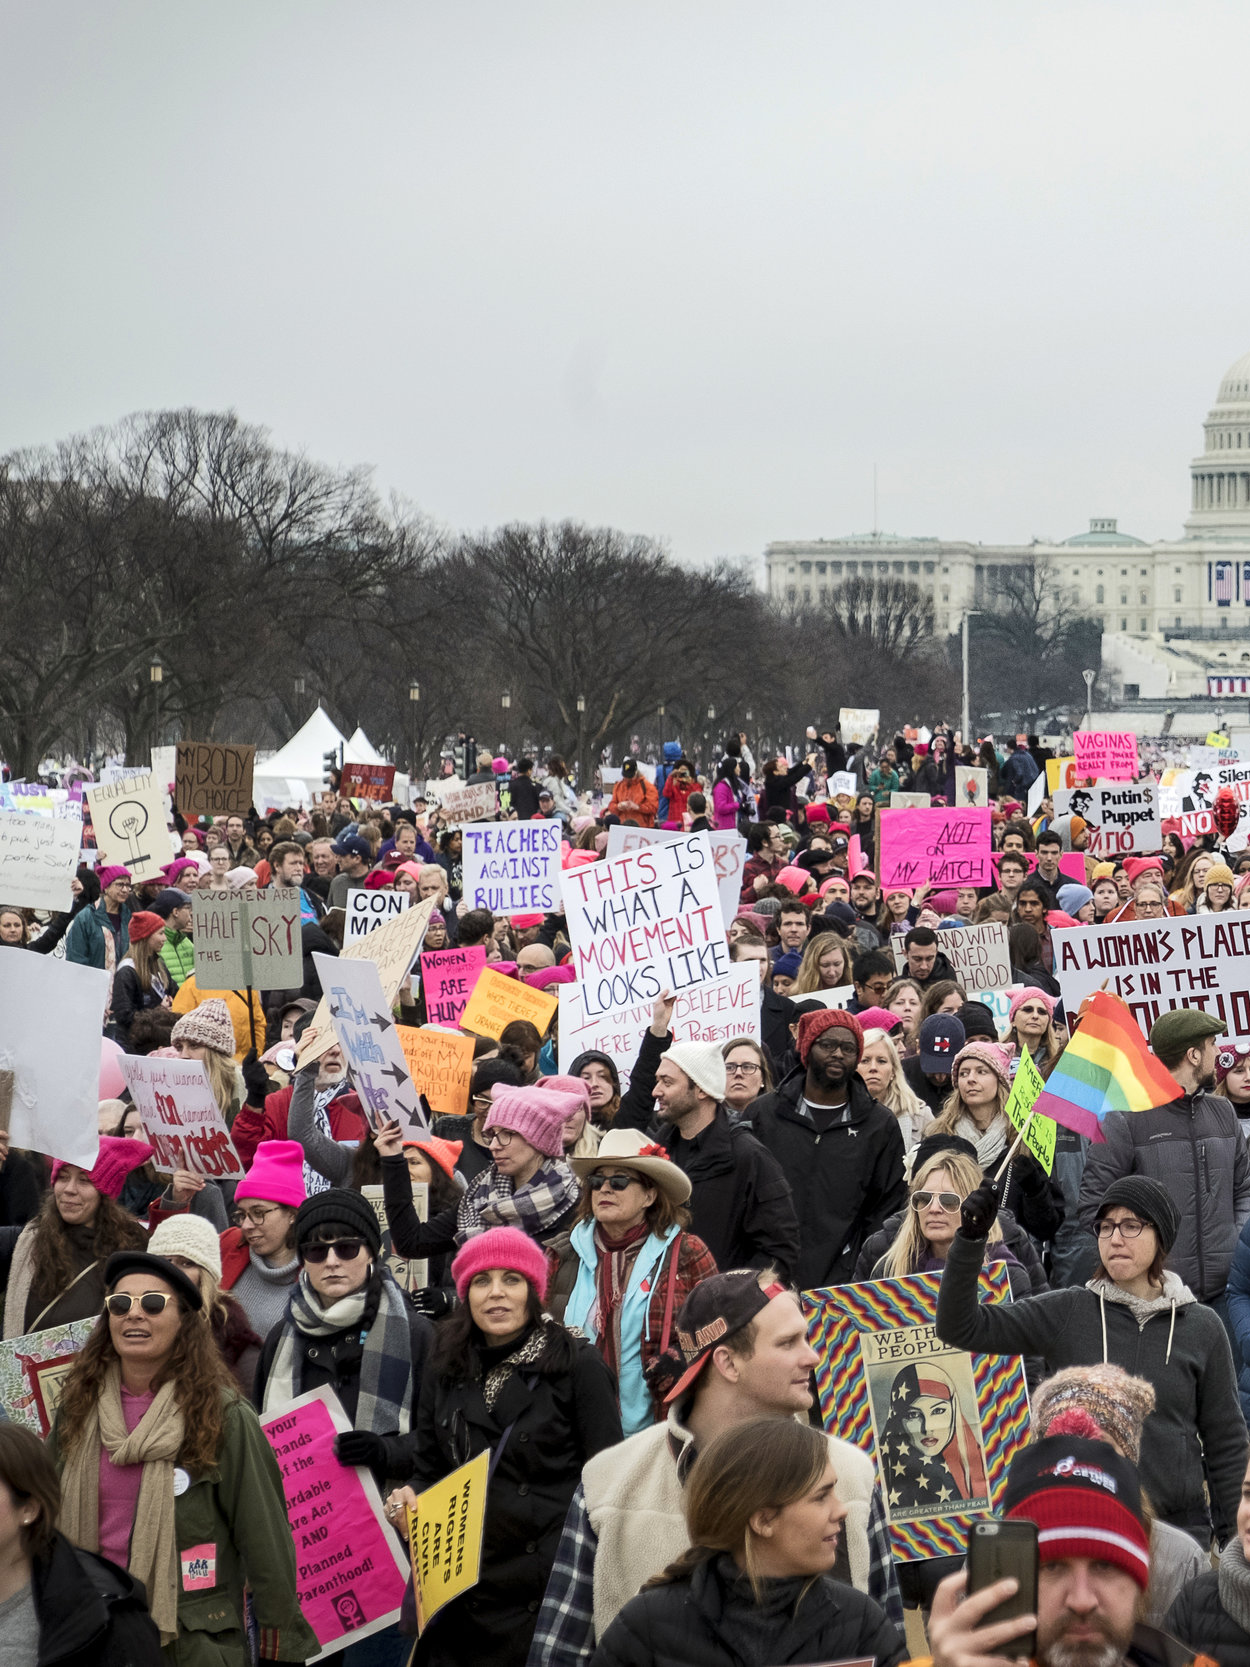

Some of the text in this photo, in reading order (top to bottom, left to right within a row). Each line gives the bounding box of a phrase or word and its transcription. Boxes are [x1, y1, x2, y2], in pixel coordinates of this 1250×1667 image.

[1076, 733, 1132, 749] VAGINAS
[177, 746, 249, 787] MY BODY
[1077, 751, 1107, 760] WHERE
[1077, 761, 1134, 771] REALLY FROM
[93, 774, 152, 803] EQUALITY
[193, 788, 248, 813] CHOICE
[346, 784, 389, 800] THIEF
[1102, 808, 1154, 826] Puppet
[1181, 811, 1212, 837] NO
[466, 825, 560, 854] TEACHERS
[937, 822, 982, 844] NOT
[926, 844, 945, 857] ON
[480, 857, 549, 879] AGAINST
[568, 853, 657, 902] THIS
[665, 837, 705, 878] IS
[889, 859, 984, 883] MY WATCH
[197, 888, 298, 901] WOMEN ARE
[353, 893, 403, 914] CON
[475, 884, 553, 911] BULLIES
[583, 878, 700, 935] WHAT A
[196, 911, 298, 956] HALF SKY
[351, 916, 391, 935] MA
[965, 924, 1004, 946] WITH
[578, 906, 713, 979] MOVEMENT
[1062, 941, 1081, 971] A
[1083, 929, 1175, 970] WOMAN'S
[198, 950, 223, 962] THE
[438, 978, 469, 999] ARE
[582, 965, 661, 1015] LOOKS
[668, 941, 729, 991] LIKE
[1114, 965, 1220, 998] IS IN THE
[505, 999, 538, 1019] THERE?
[676, 978, 754, 1019] BELIEVE
[872, 1331, 907, 1346] WE
[878, 1340, 953, 1360] PEOPLE
[267, 1415, 298, 1439] your
[274, 1432, 313, 1459] hands
[293, 1455, 315, 1473] the
[311, 1501, 334, 1521] Act
[892, 1500, 988, 1518] ARE GREATER THAN FEAR
[301, 1526, 330, 1549] AND
[443, 1495, 458, 1584] RIGHTS
[455, 1479, 472, 1577] WOMENS
[421, 1521, 430, 1585] CIVIL
[432, 1522, 442, 1569] ARE
[298, 1544, 353, 1580] Planned
[297, 1557, 375, 1605] Parenthood!
